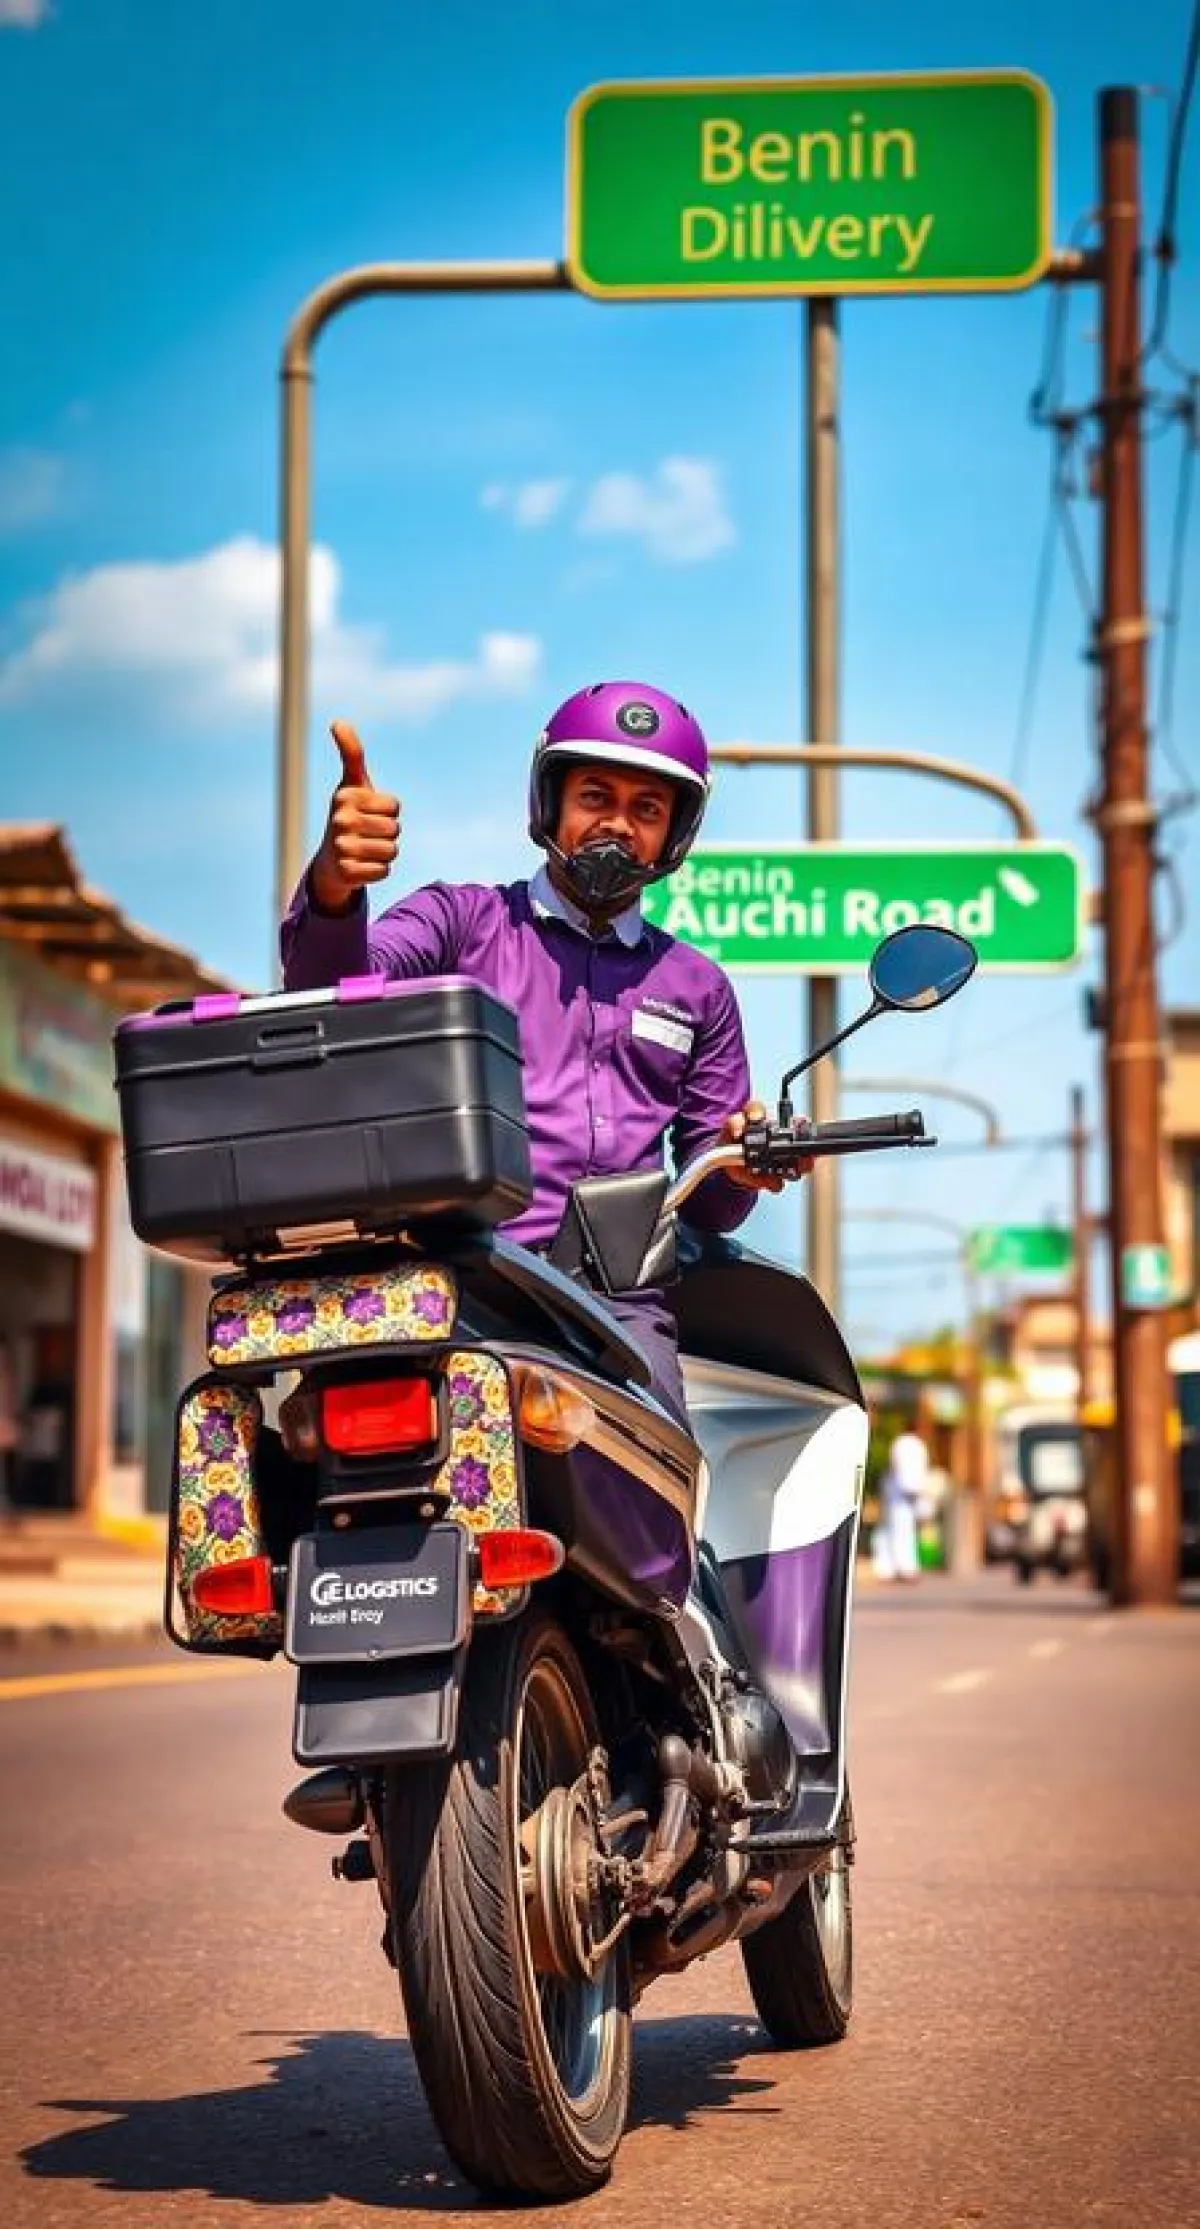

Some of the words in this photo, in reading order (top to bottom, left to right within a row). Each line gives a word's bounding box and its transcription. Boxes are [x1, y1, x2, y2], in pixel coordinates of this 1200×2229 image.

[700, 110, 917, 184] Benin
[680, 202, 934, 272] Dilivery
[667, 859, 795, 897] Benin
[663, 887, 828, 938] Auchi
[842, 886, 996, 938] Road
